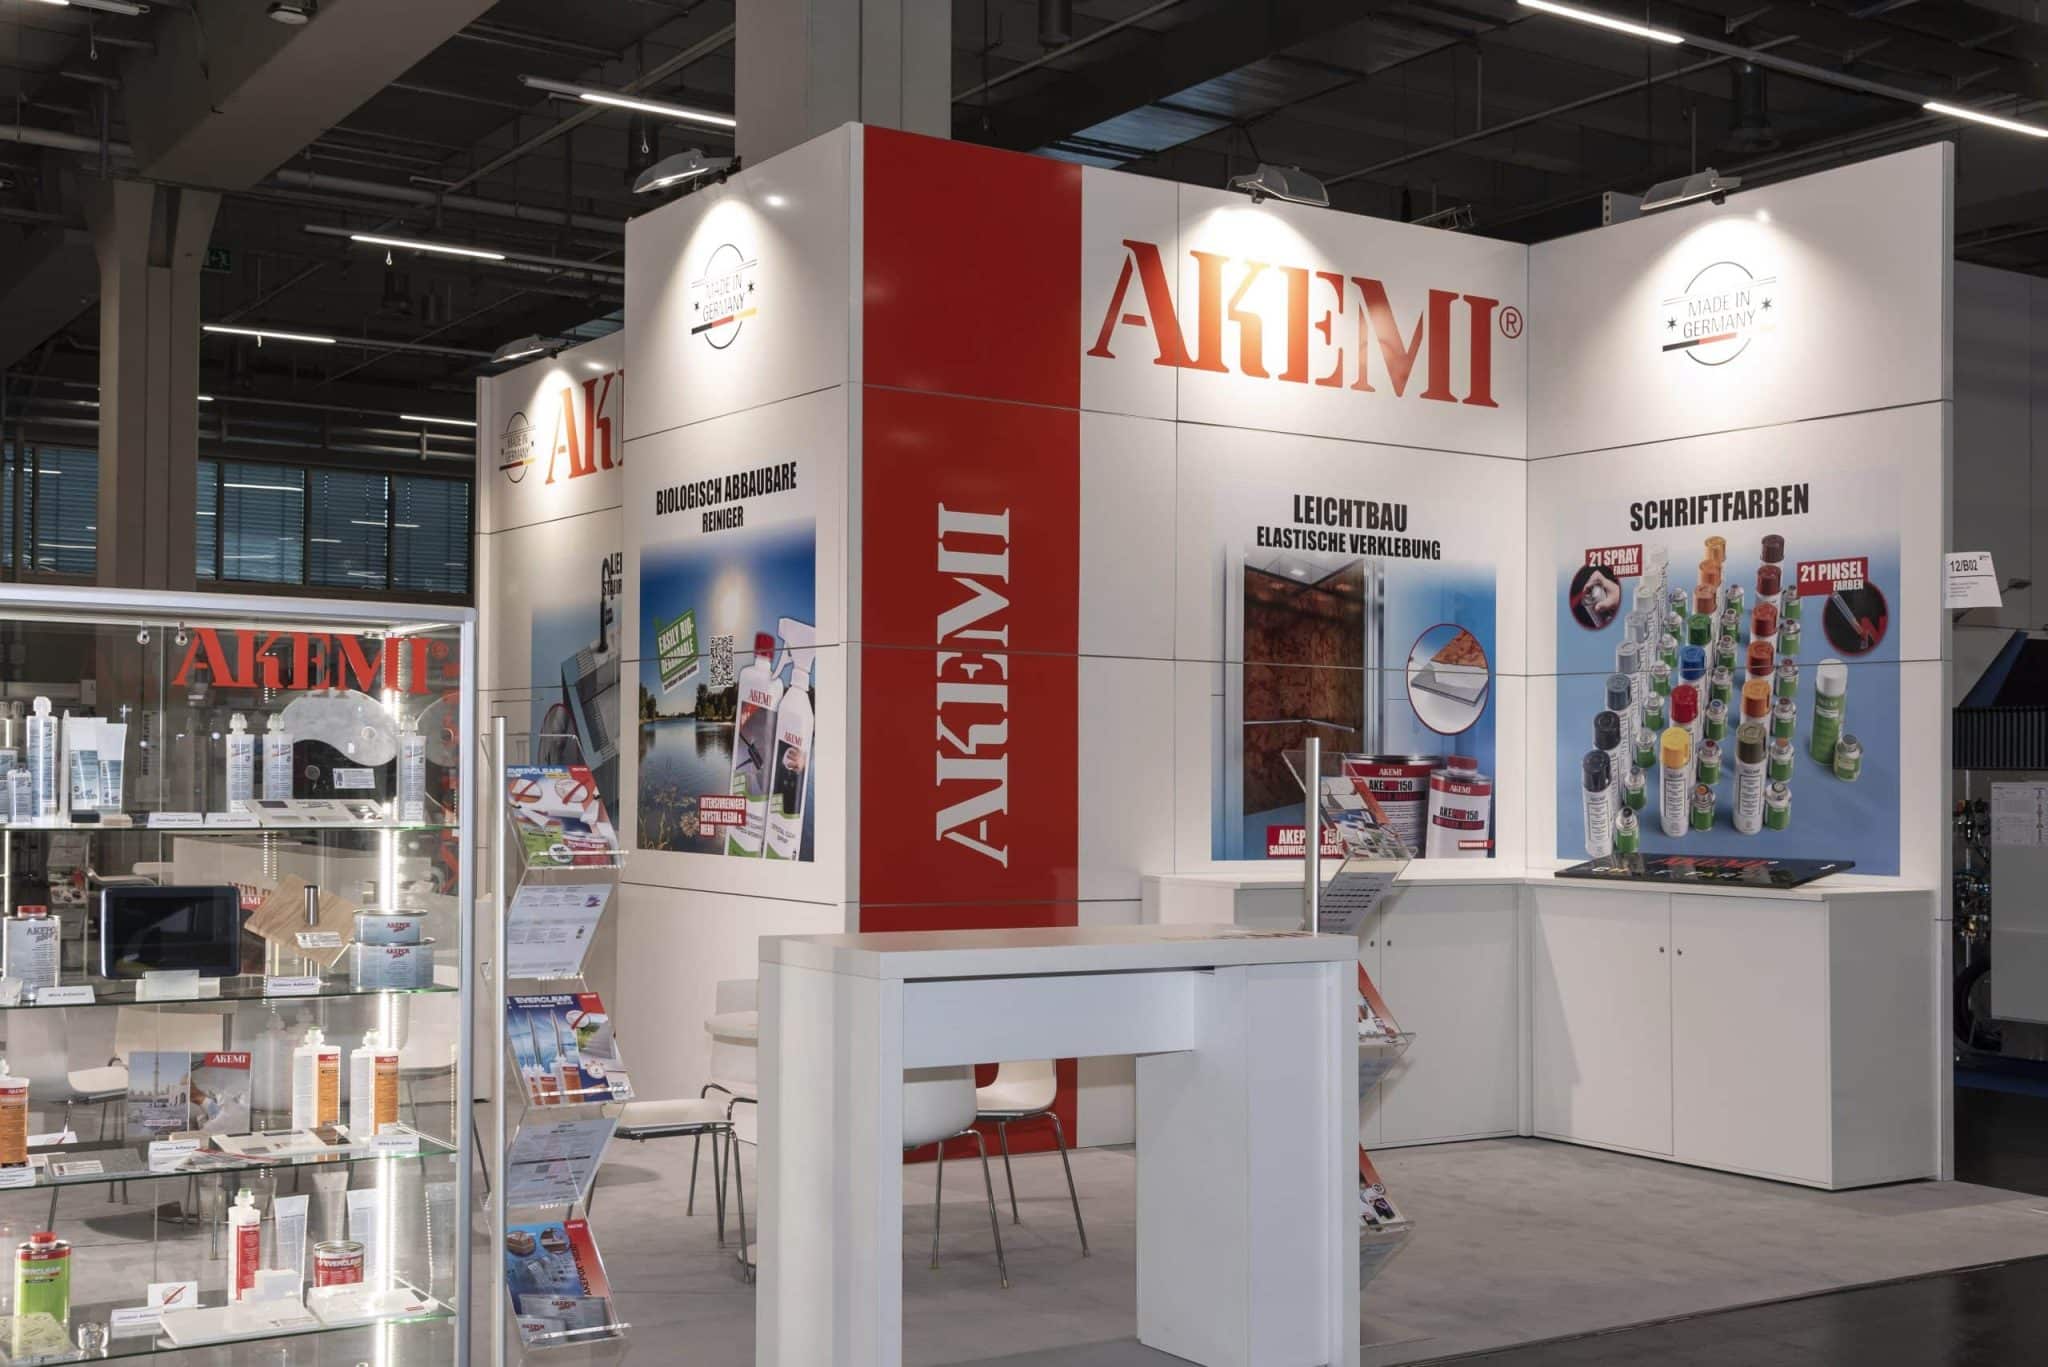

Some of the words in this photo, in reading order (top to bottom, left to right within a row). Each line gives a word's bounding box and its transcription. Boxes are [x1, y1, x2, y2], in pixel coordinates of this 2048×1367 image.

[1688, 294, 1730, 318] MADE
[1735, 290, 1751, 308] IN
[1683, 309, 1756, 339] GERMANY
[545, 369, 624, 485] AK
[656, 477, 722, 516] BIOLOGISCH
[724, 461, 797, 502] ABBAUBARE
[702, 505, 744, 534] REINIGER
[1293, 494, 1408, 533] LEICHTBAU
[1630, 483, 1809, 532] SCHRIFTFARBEN
[1256, 526, 1346, 553] ELASTISCHE
[1349, 533, 1441, 560] VERKLEBUNG
[1589, 551, 1602, 567] 21
[1603, 547, 1639, 566] SPRAY
[1613, 564, 1639, 577] FARBEN
[1800, 564, 1816, 583] 21
[1818, 560, 1864, 581] PINSEL
[1832, 578, 1864, 592] FARBEN
[936, 502, 1010, 868] AKEMI
[1379, 767, 1403, 777] AKEMI
[1448, 784, 1472, 794] AKEMI
[213, 1054, 248, 1064] AKEMI
